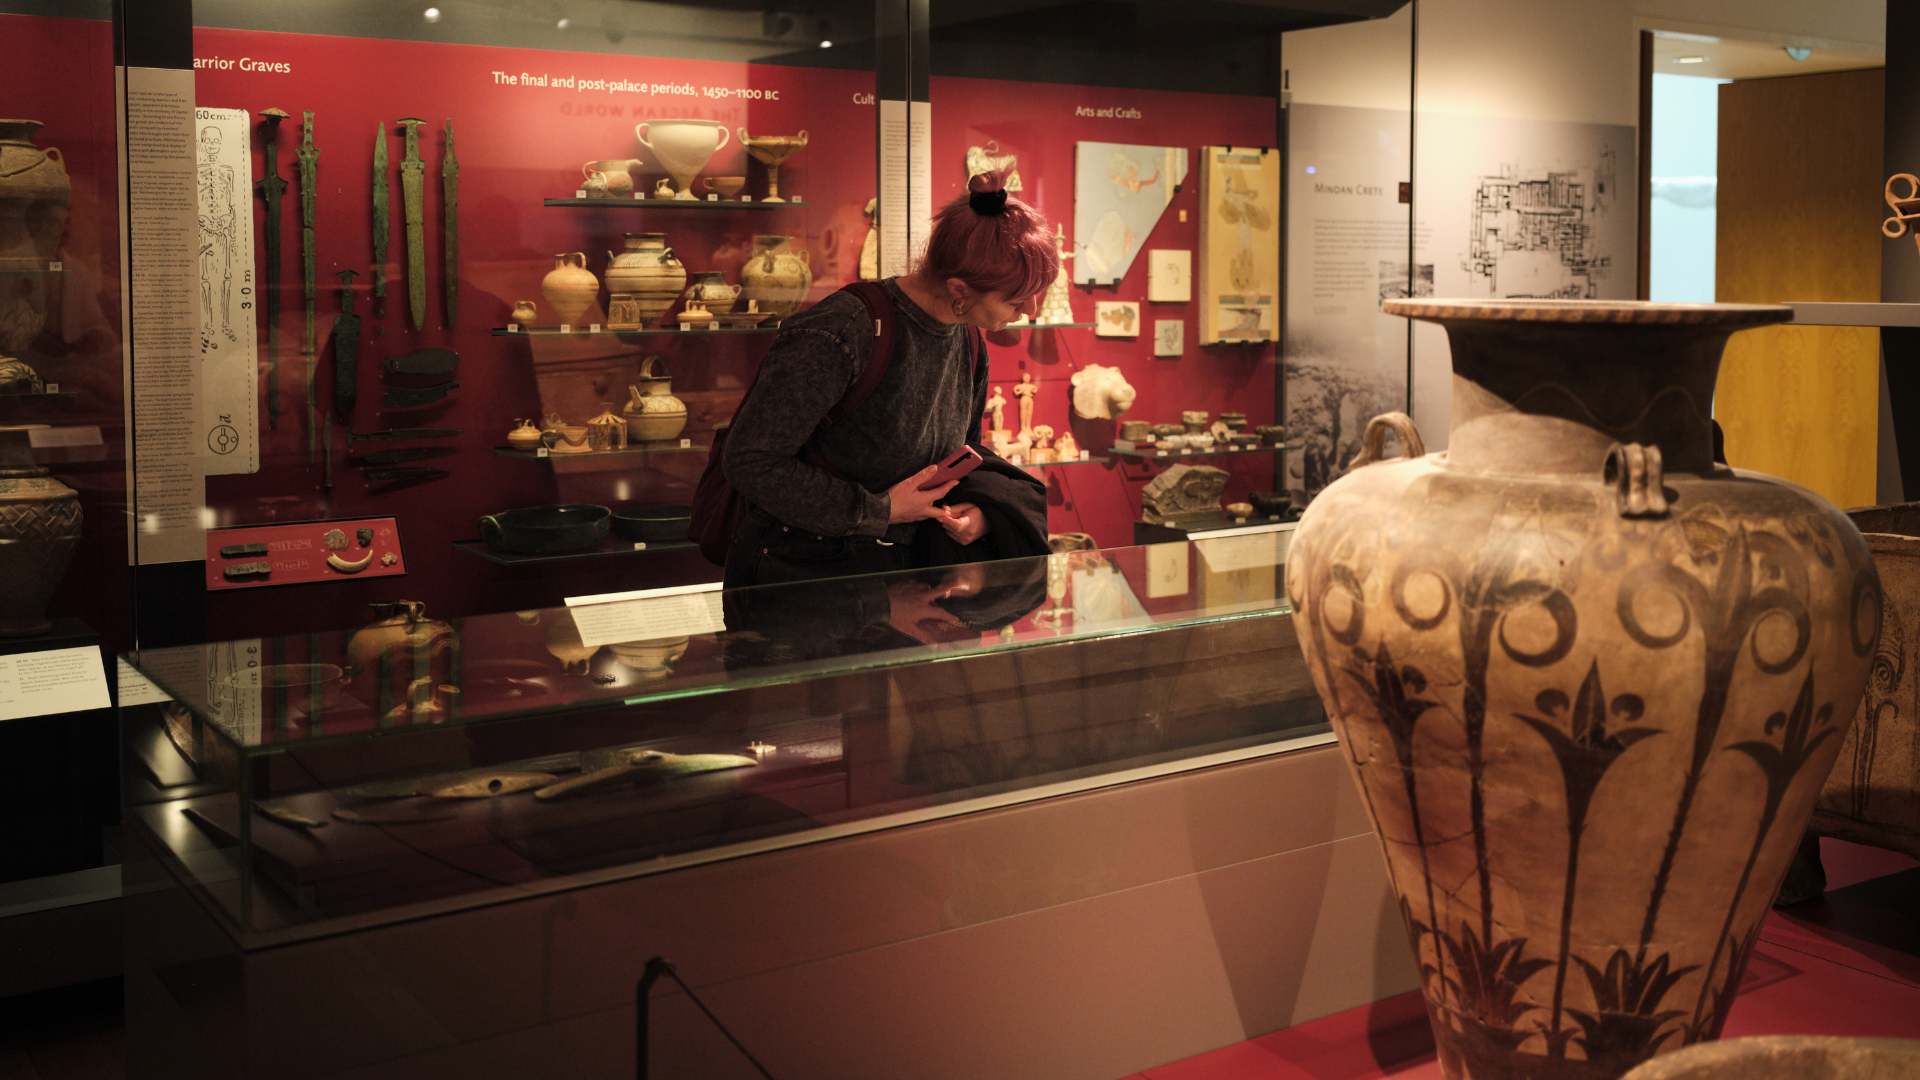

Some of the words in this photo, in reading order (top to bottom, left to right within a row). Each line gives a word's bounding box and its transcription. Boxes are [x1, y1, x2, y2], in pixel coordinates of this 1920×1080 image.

[193, 56, 235, 70] arrior
[239, 57, 291, 73] Graves
[492, 71, 518, 86] The
[520, 73, 548, 87] final
[551, 75, 575, 89] and
[578, 78, 648, 95] post-palace
[651, 82, 699, 97] periods,
[764, 90, 780, 100] BC
[852, 92, 875, 106] Cult
[196, 110, 210, 120] 60
[1075, 105, 1095, 118] Arts
[1096, 106, 1114, 118] and
[1115, 106, 1142, 119] Crafts
